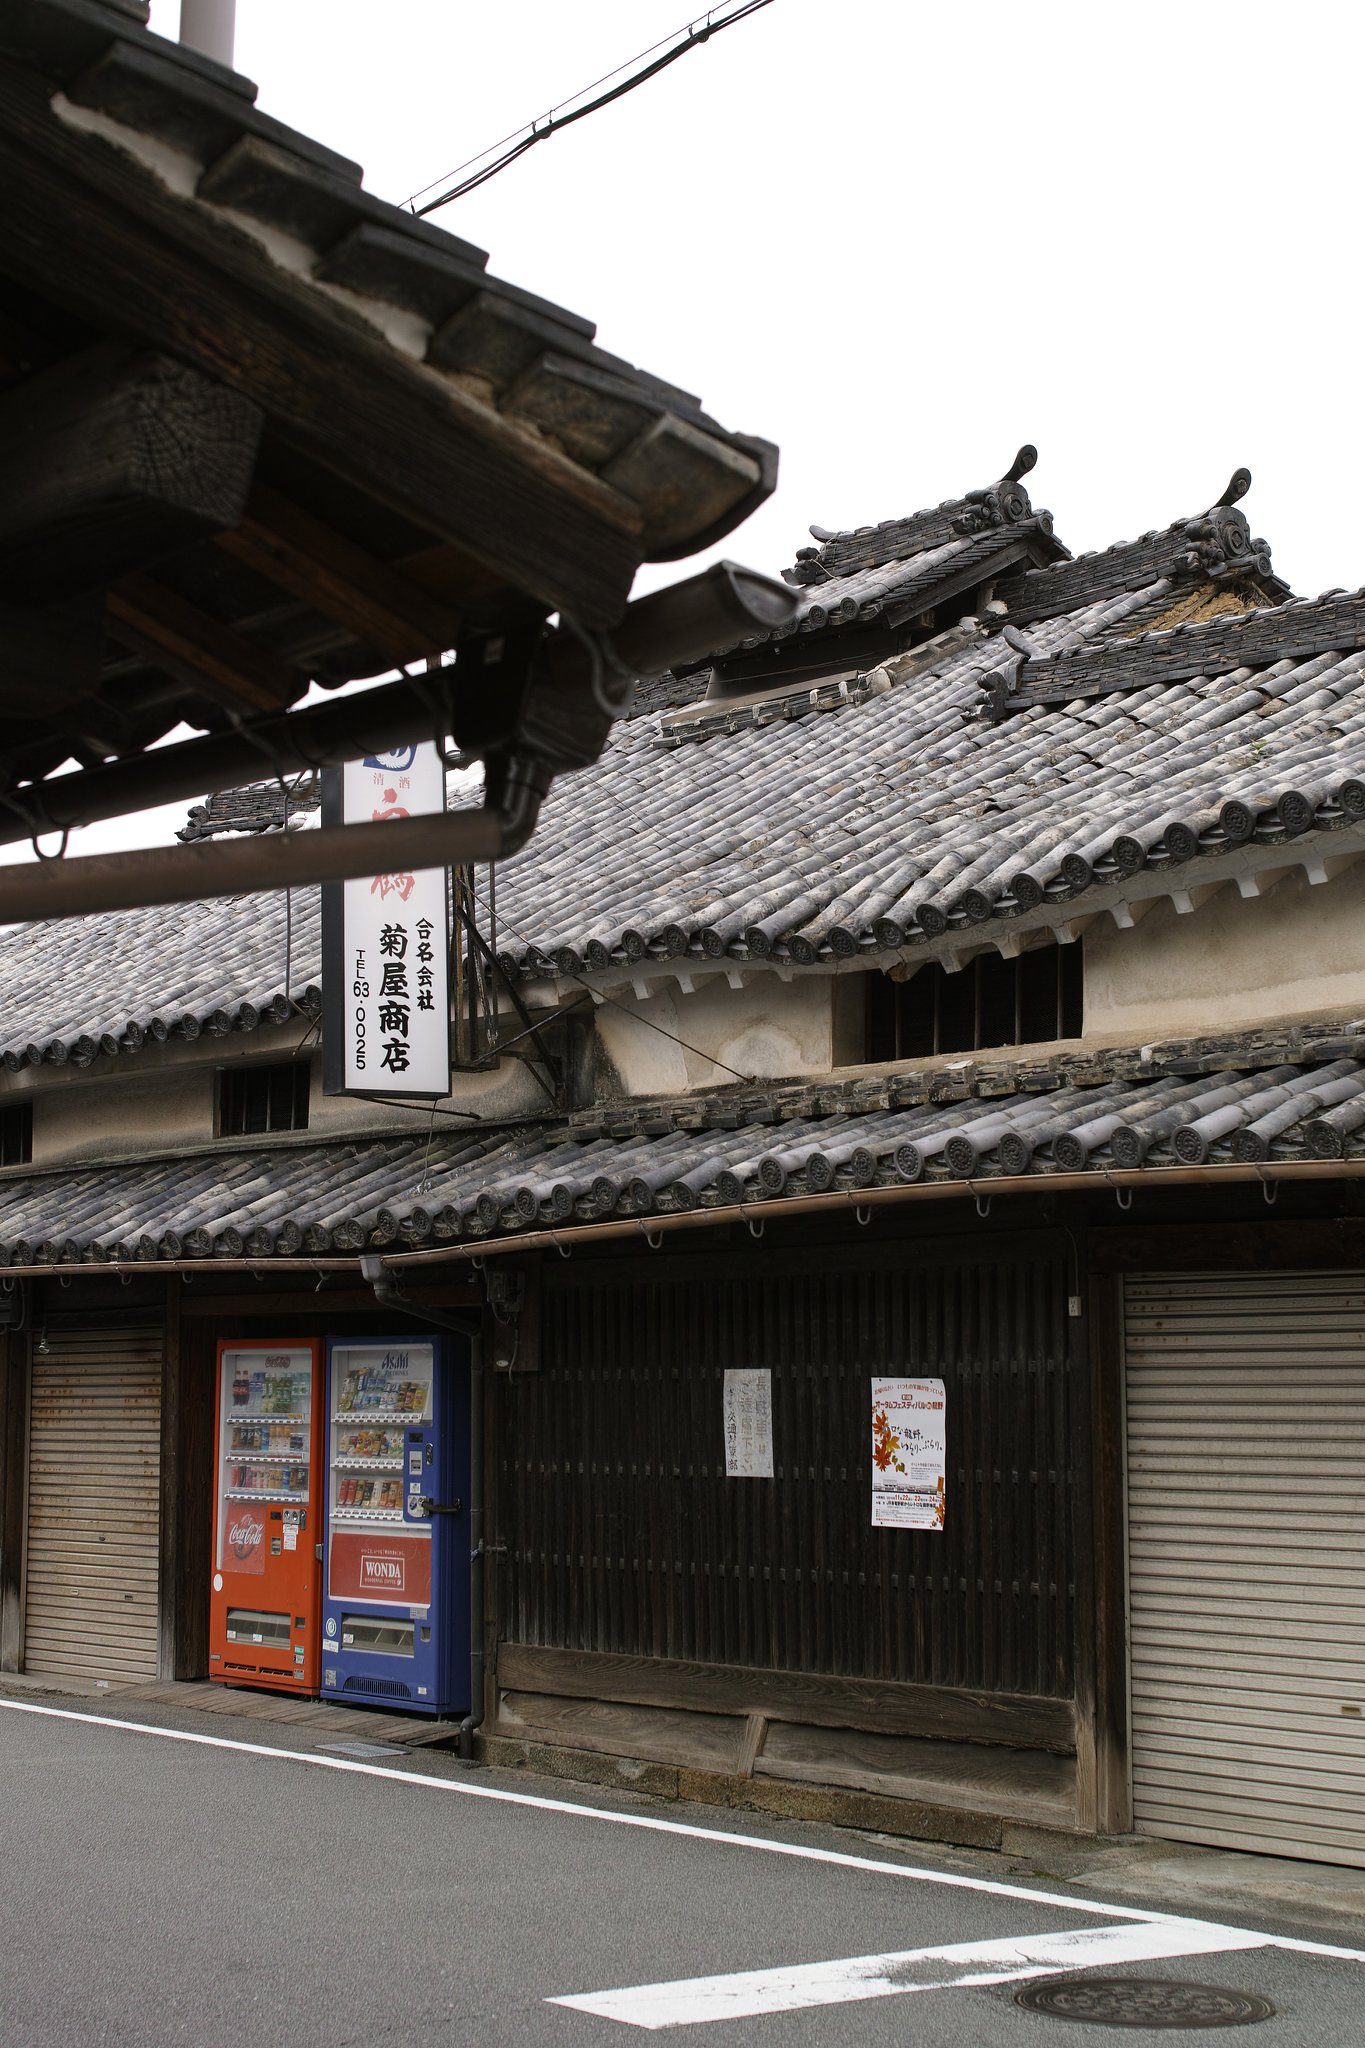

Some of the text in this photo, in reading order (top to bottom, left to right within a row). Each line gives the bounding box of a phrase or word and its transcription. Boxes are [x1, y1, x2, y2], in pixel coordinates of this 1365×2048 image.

[415, 917, 435, 1011] 合名会社
[378, 923, 411, 1074] 菊屋商店
[381, 1351, 408, 1370] Asahi
[229, 1523, 265, 1545] Coca-Cola
[365, 1561, 402, 1578] WONDA
